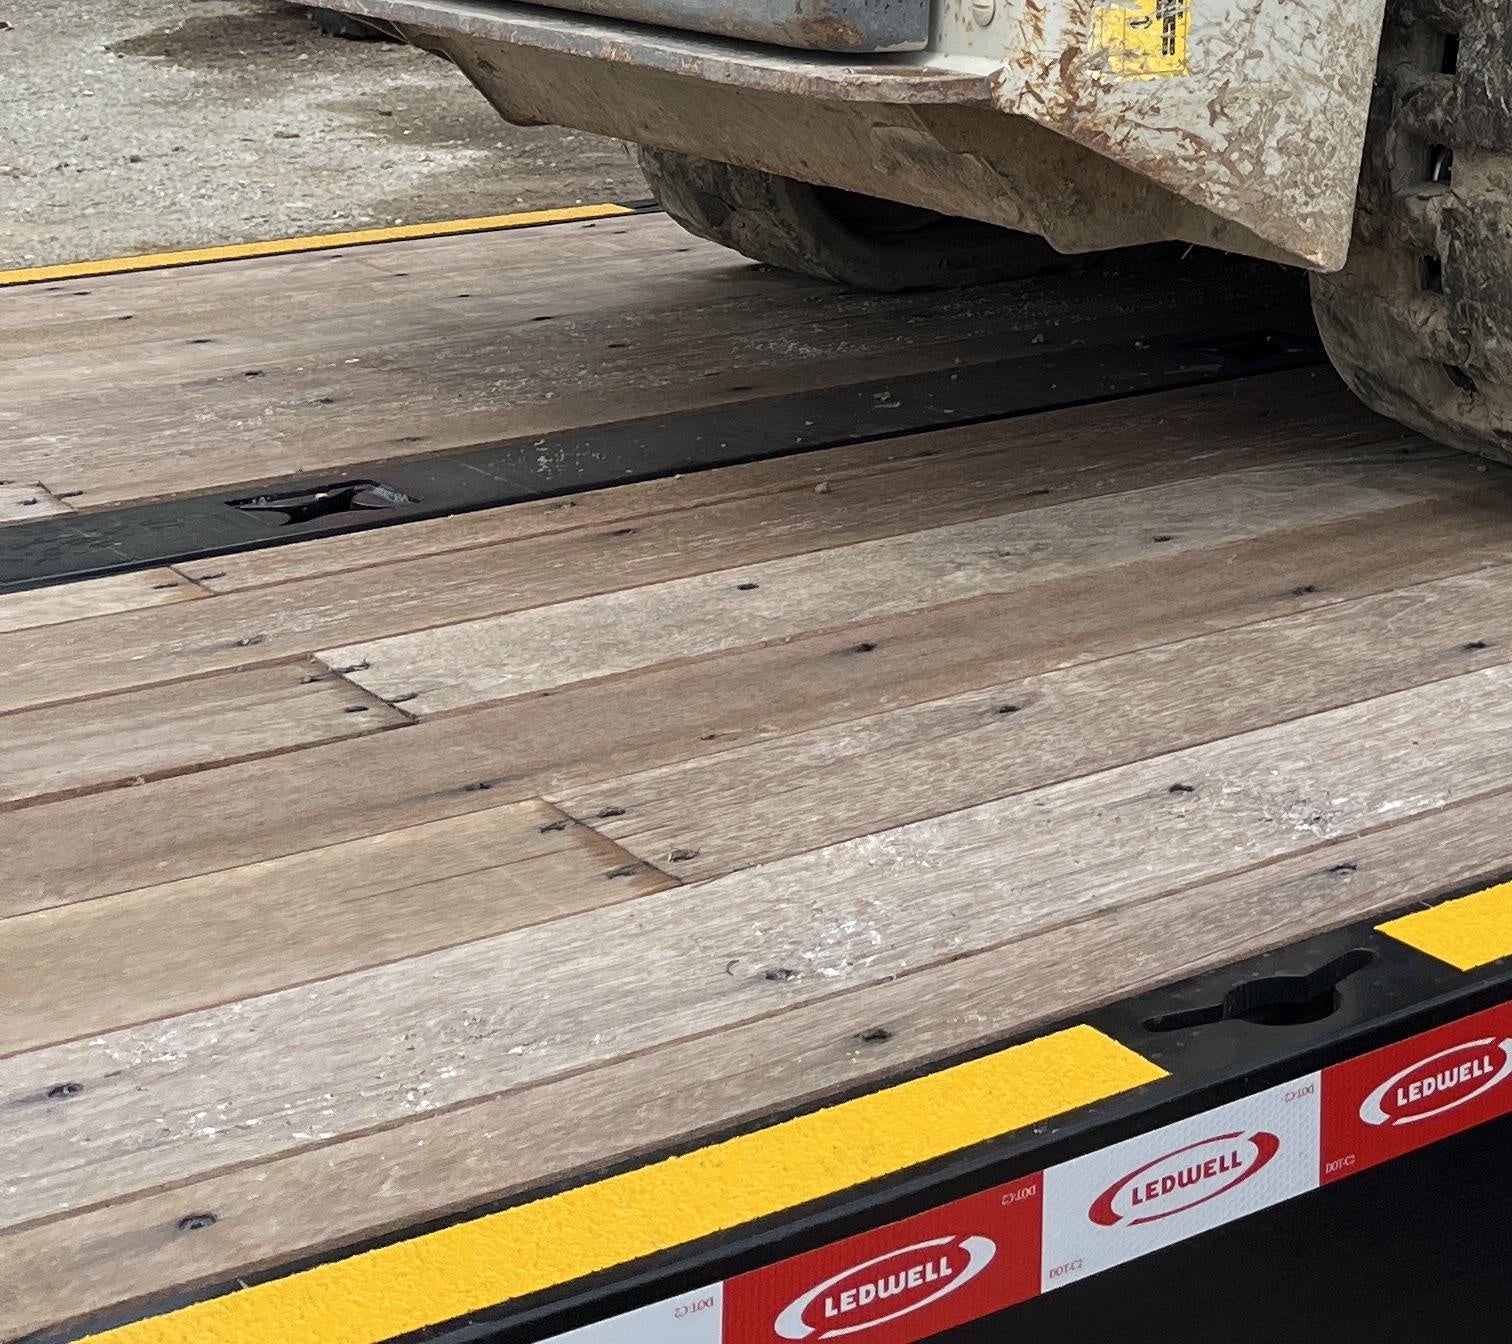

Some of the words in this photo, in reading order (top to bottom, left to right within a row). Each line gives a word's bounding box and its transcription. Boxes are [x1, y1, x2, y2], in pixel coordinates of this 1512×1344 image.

[1396, 1055, 1494, 1107] LEDWELL
[1131, 1150, 1243, 1207] LEDWELL
[824, 1256, 952, 1319] LEDWELL
[1049, 1258, 1083, 1279] DOT-C2
[674, 1296, 714, 1319] DOT-C2
